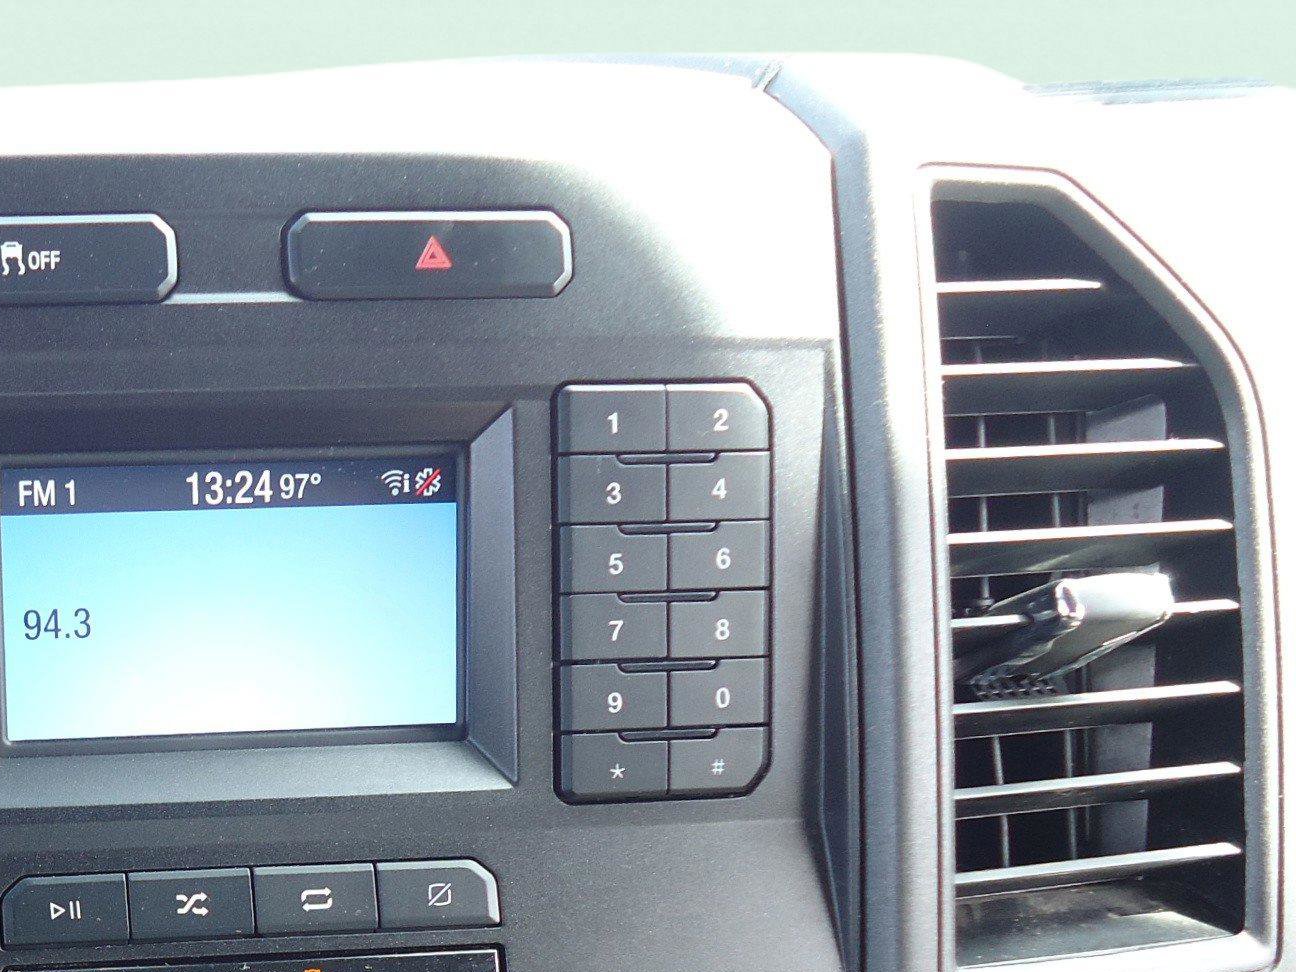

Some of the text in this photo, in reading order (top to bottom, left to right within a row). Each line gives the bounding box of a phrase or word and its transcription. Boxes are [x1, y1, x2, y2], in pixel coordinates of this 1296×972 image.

[28, 250, 61, 271] OFF
[607, 412, 619, 434] 1
[713, 408, 730, 432] 2
[18, 479, 77, 507] FM 1
[185, 469, 274, 506] 13:24
[606, 481, 622, 506] 3
[711, 477, 728, 500] 4
[608, 553, 624, 575] 5
[715, 547, 732, 570] 6
[23, 607, 92, 642] 94.3
[607, 619, 624, 642] 7
[714, 618, 730, 641] 8
[607, 691, 623, 714] 9
[715, 687, 731, 709] 0
